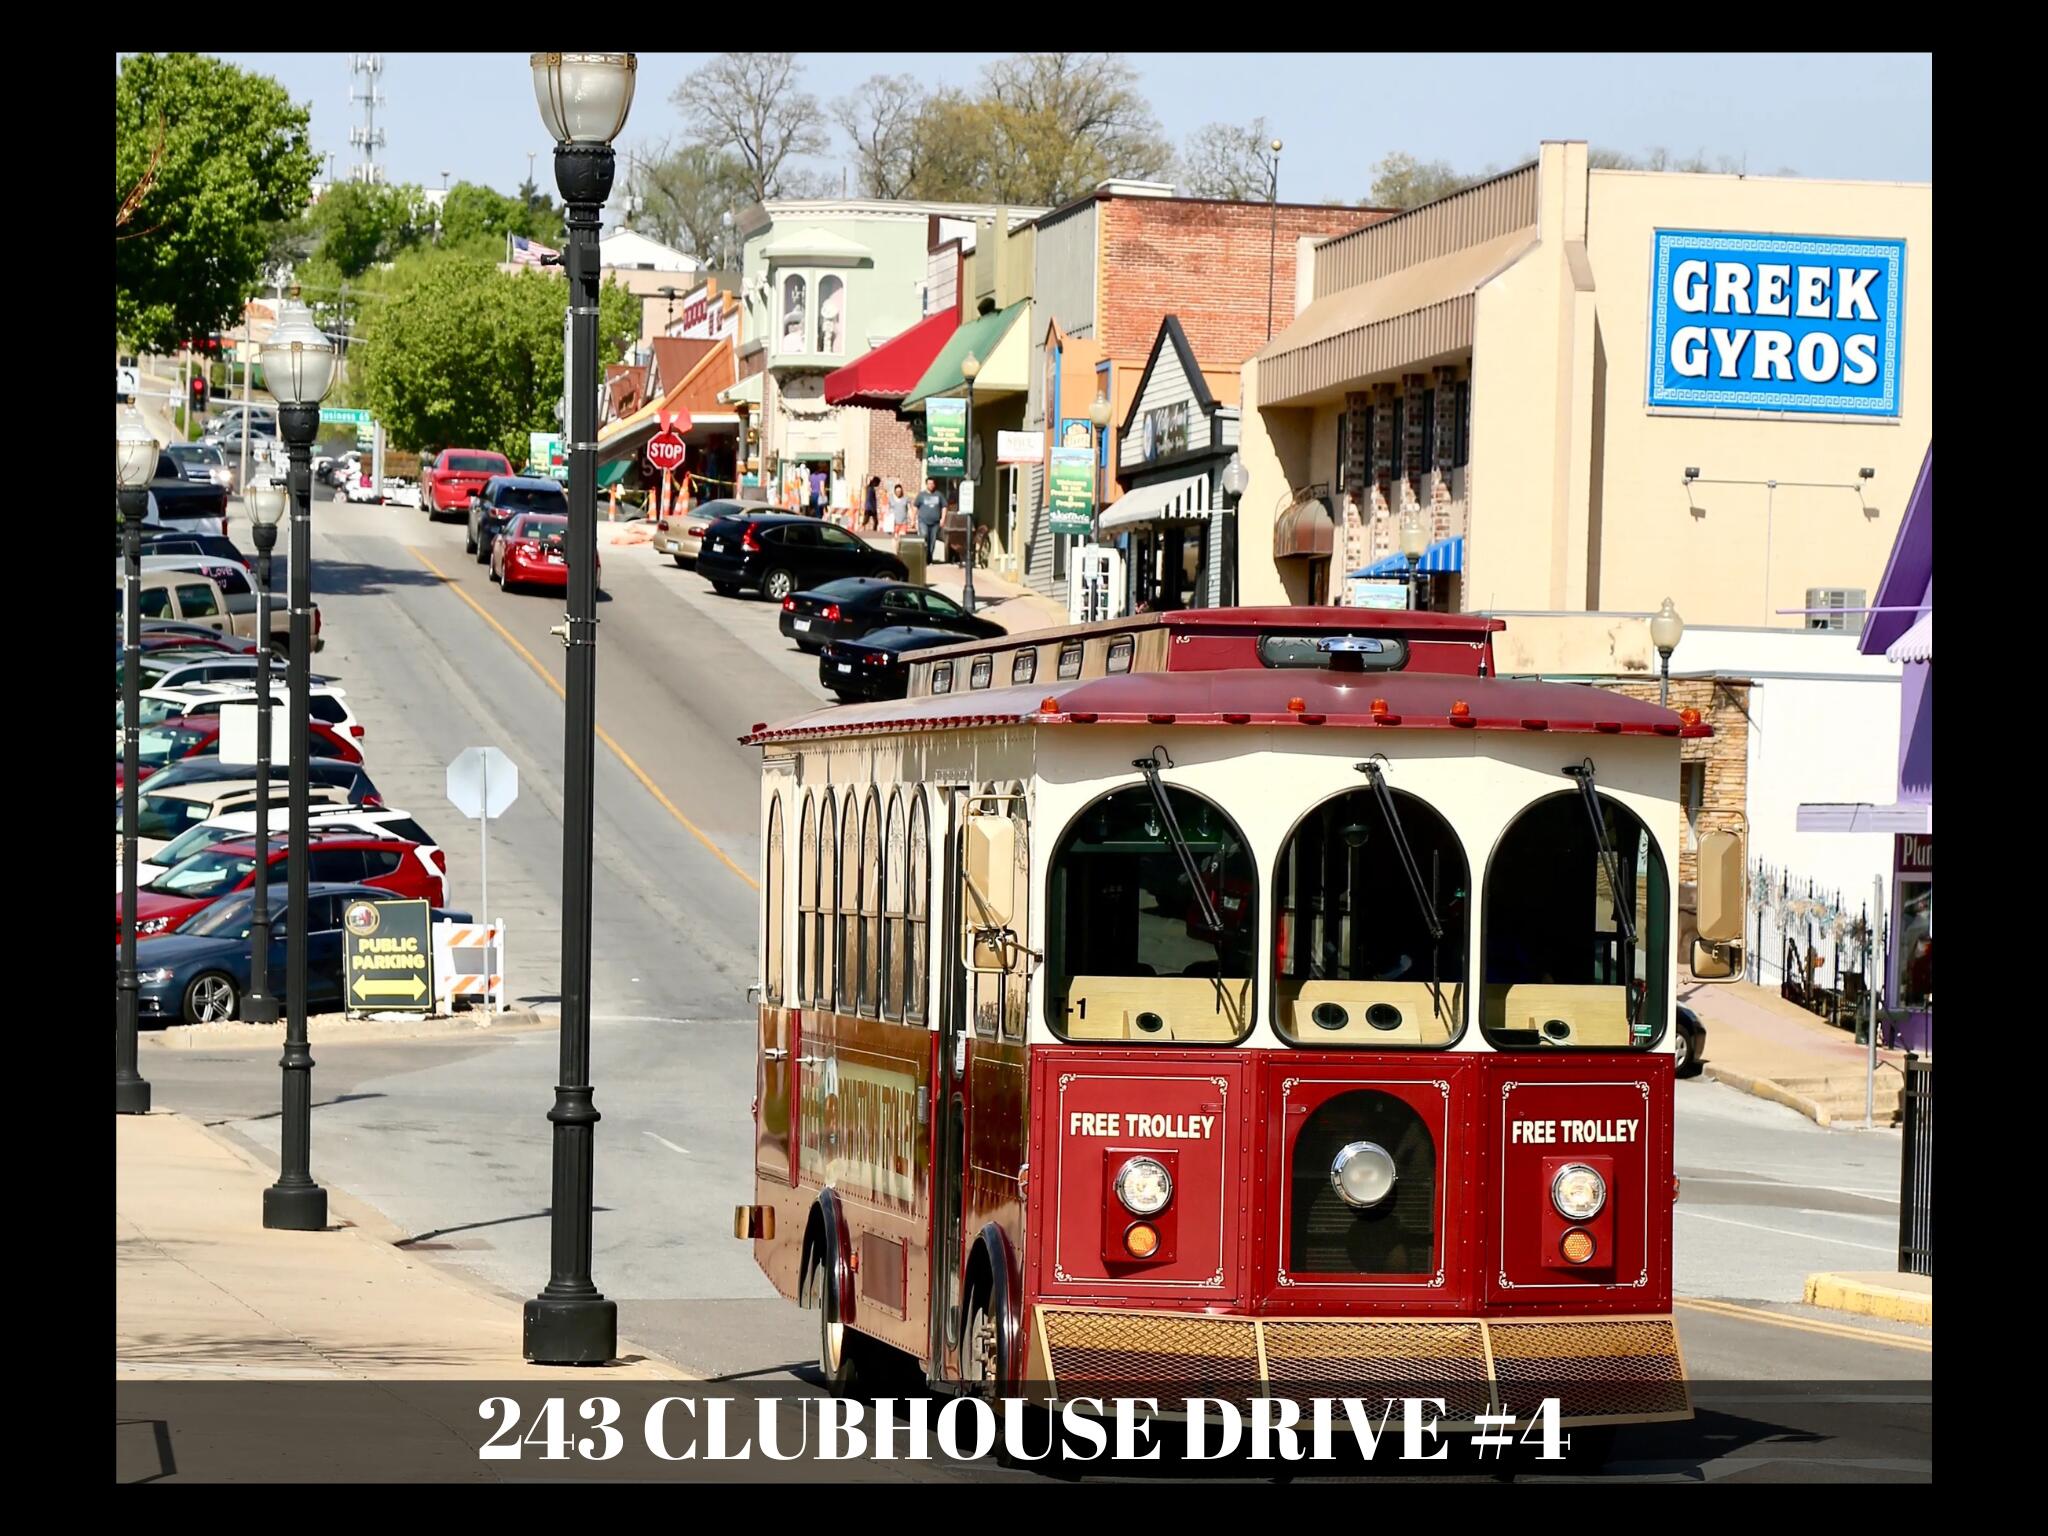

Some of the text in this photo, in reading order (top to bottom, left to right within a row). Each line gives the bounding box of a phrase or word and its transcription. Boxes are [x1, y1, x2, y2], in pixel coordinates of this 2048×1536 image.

[1672, 259, 1880, 320] GREEK
[1670, 326, 1878, 385] GYROS
[650, 442, 683, 460] STOP
[358, 937, 418, 953] PUBLIC
[352, 953, 426, 970] PARKING
[1070, 1112, 1216, 1140] FREE TROLLEY
[1512, 1118, 1640, 1144] FREE TROLLEY
